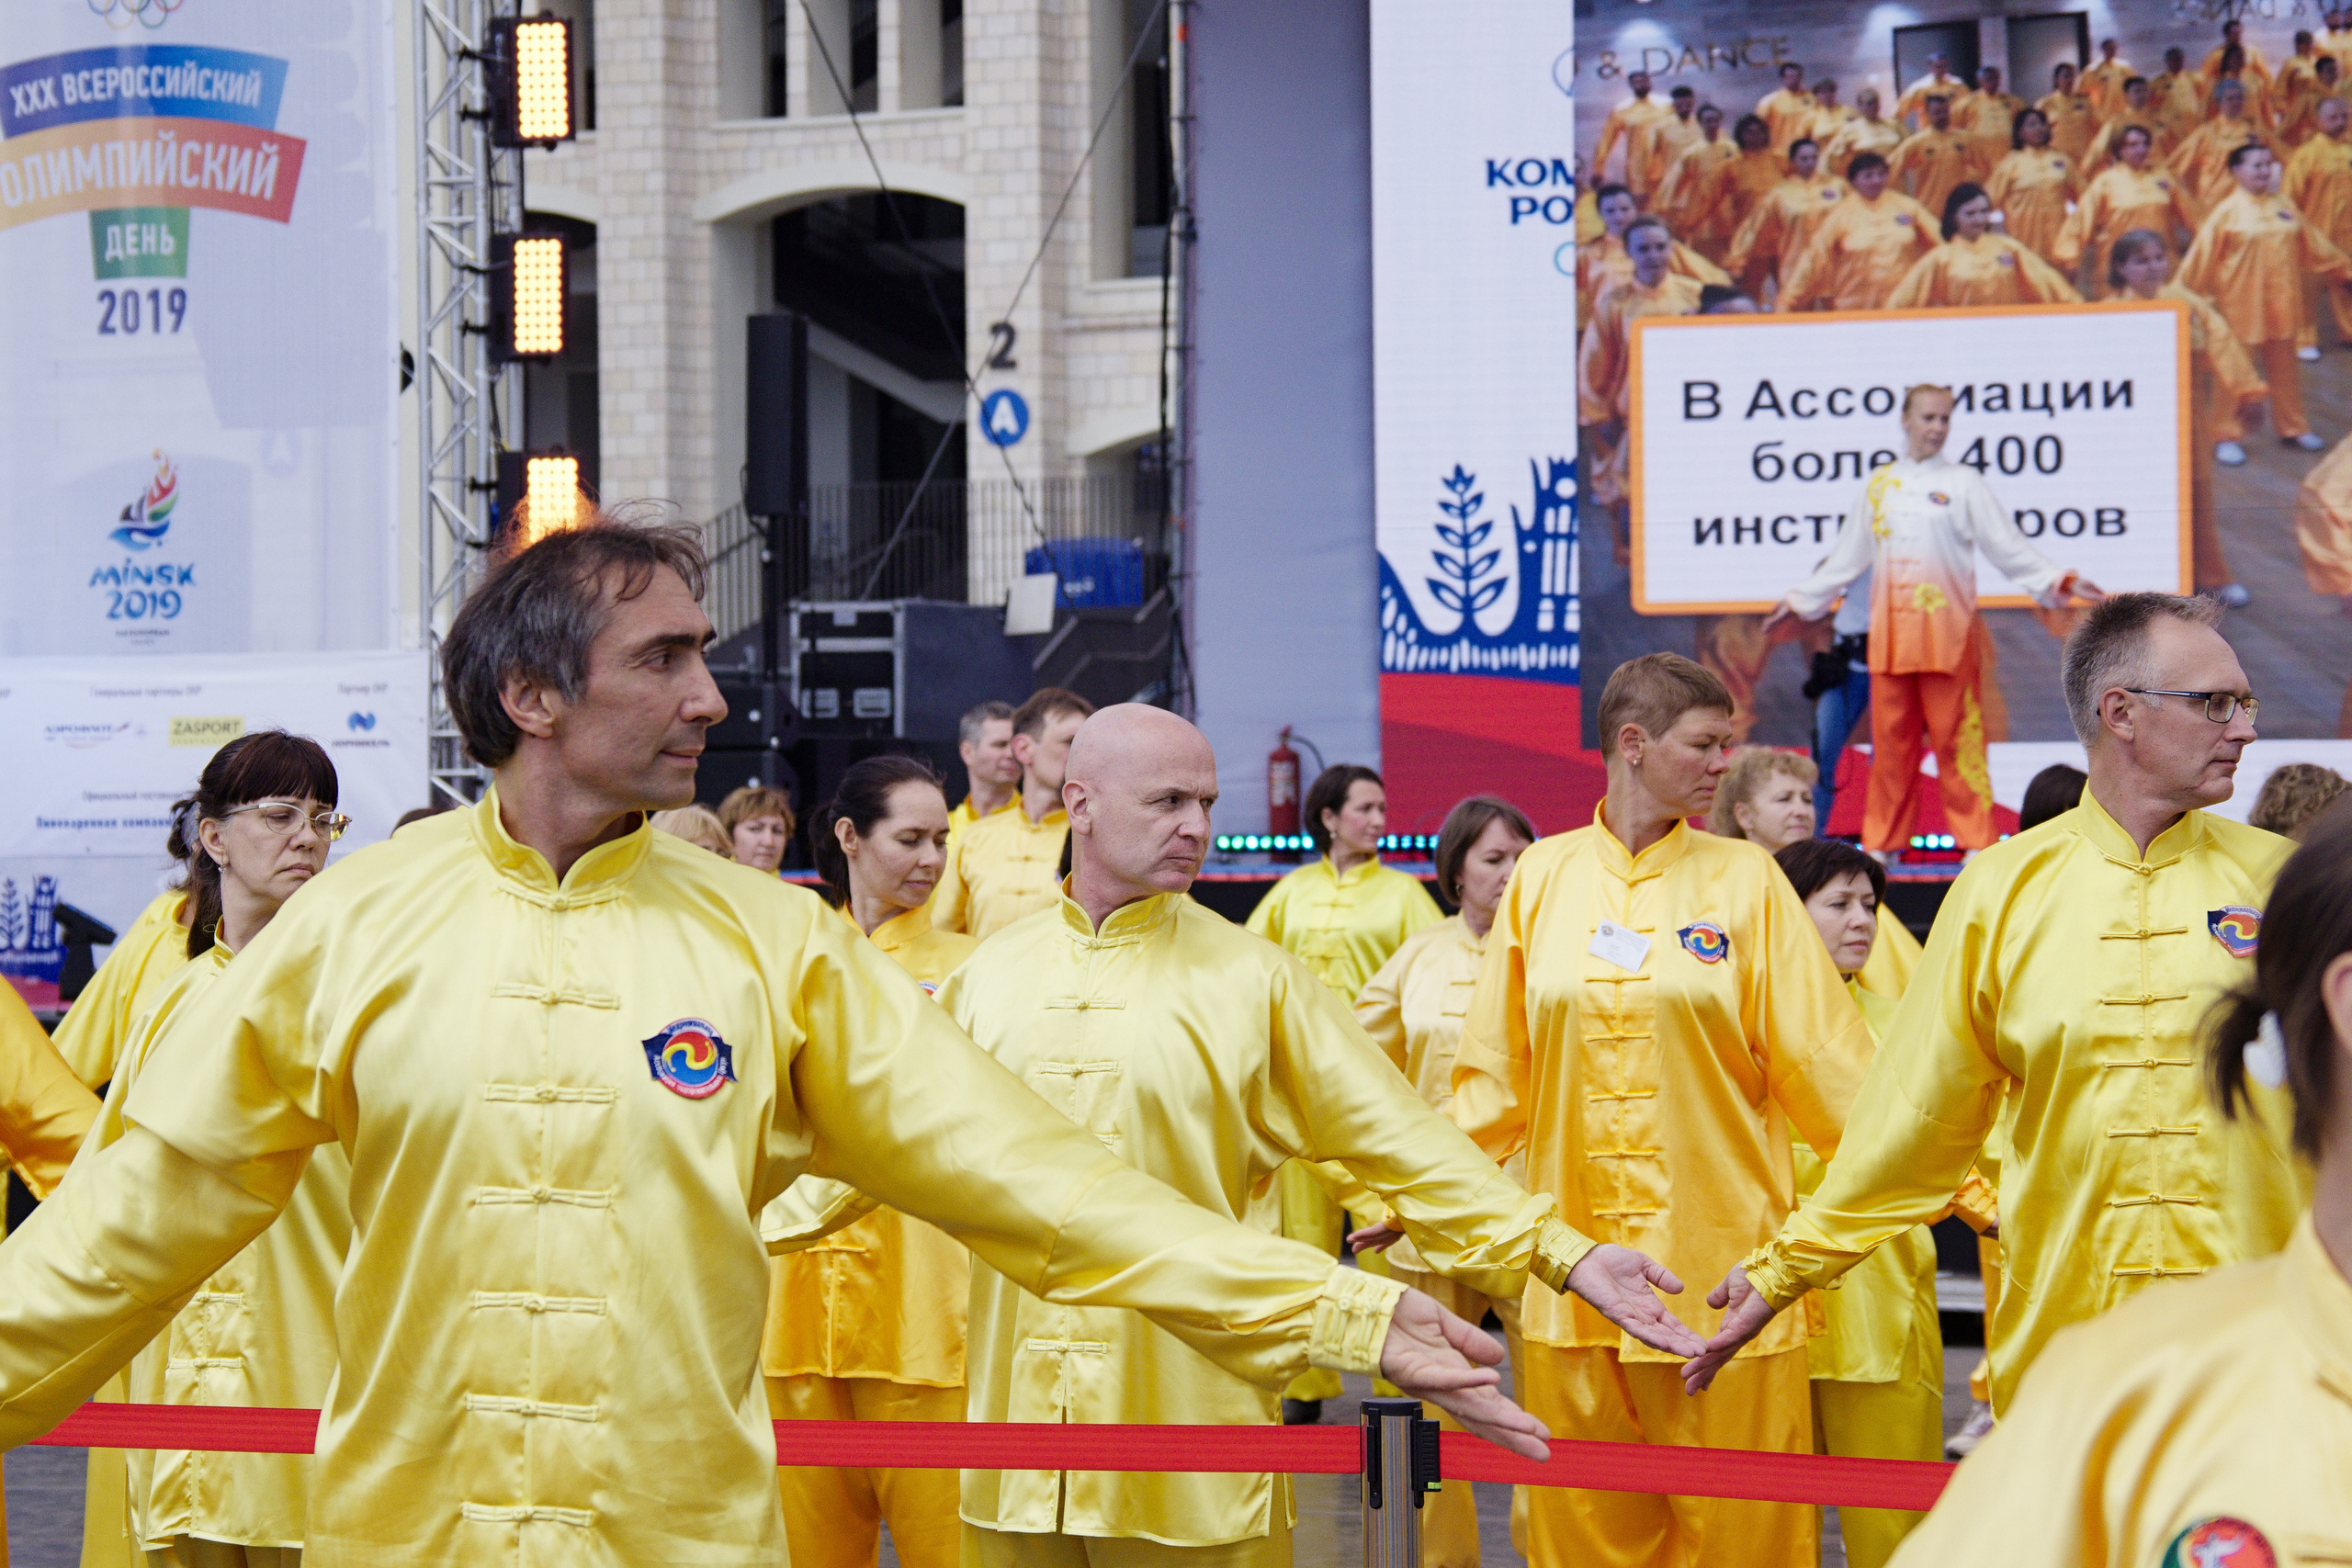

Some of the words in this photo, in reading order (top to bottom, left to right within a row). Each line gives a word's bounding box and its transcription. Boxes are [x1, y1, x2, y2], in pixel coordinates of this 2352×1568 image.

[1641, 38, 1792, 78] DANCE
[62, 61, 263, 107] ВСЕРОССИЙСКИЙ
[2, 130, 281, 208] ОЛИМПИЙСКИЙ
[105, 223, 175, 263] ДЕНЬ
[97, 287, 187, 335] 2019
[989, 321, 1017, 369] 2
[1683, 380, 1722, 420] В
[1745, 378, 2134, 419] Ассоиации
[1960, 434, 2064, 475] 400
[106, 589, 182, 621] 2019
[173, 720, 241, 735] ZASPORT
